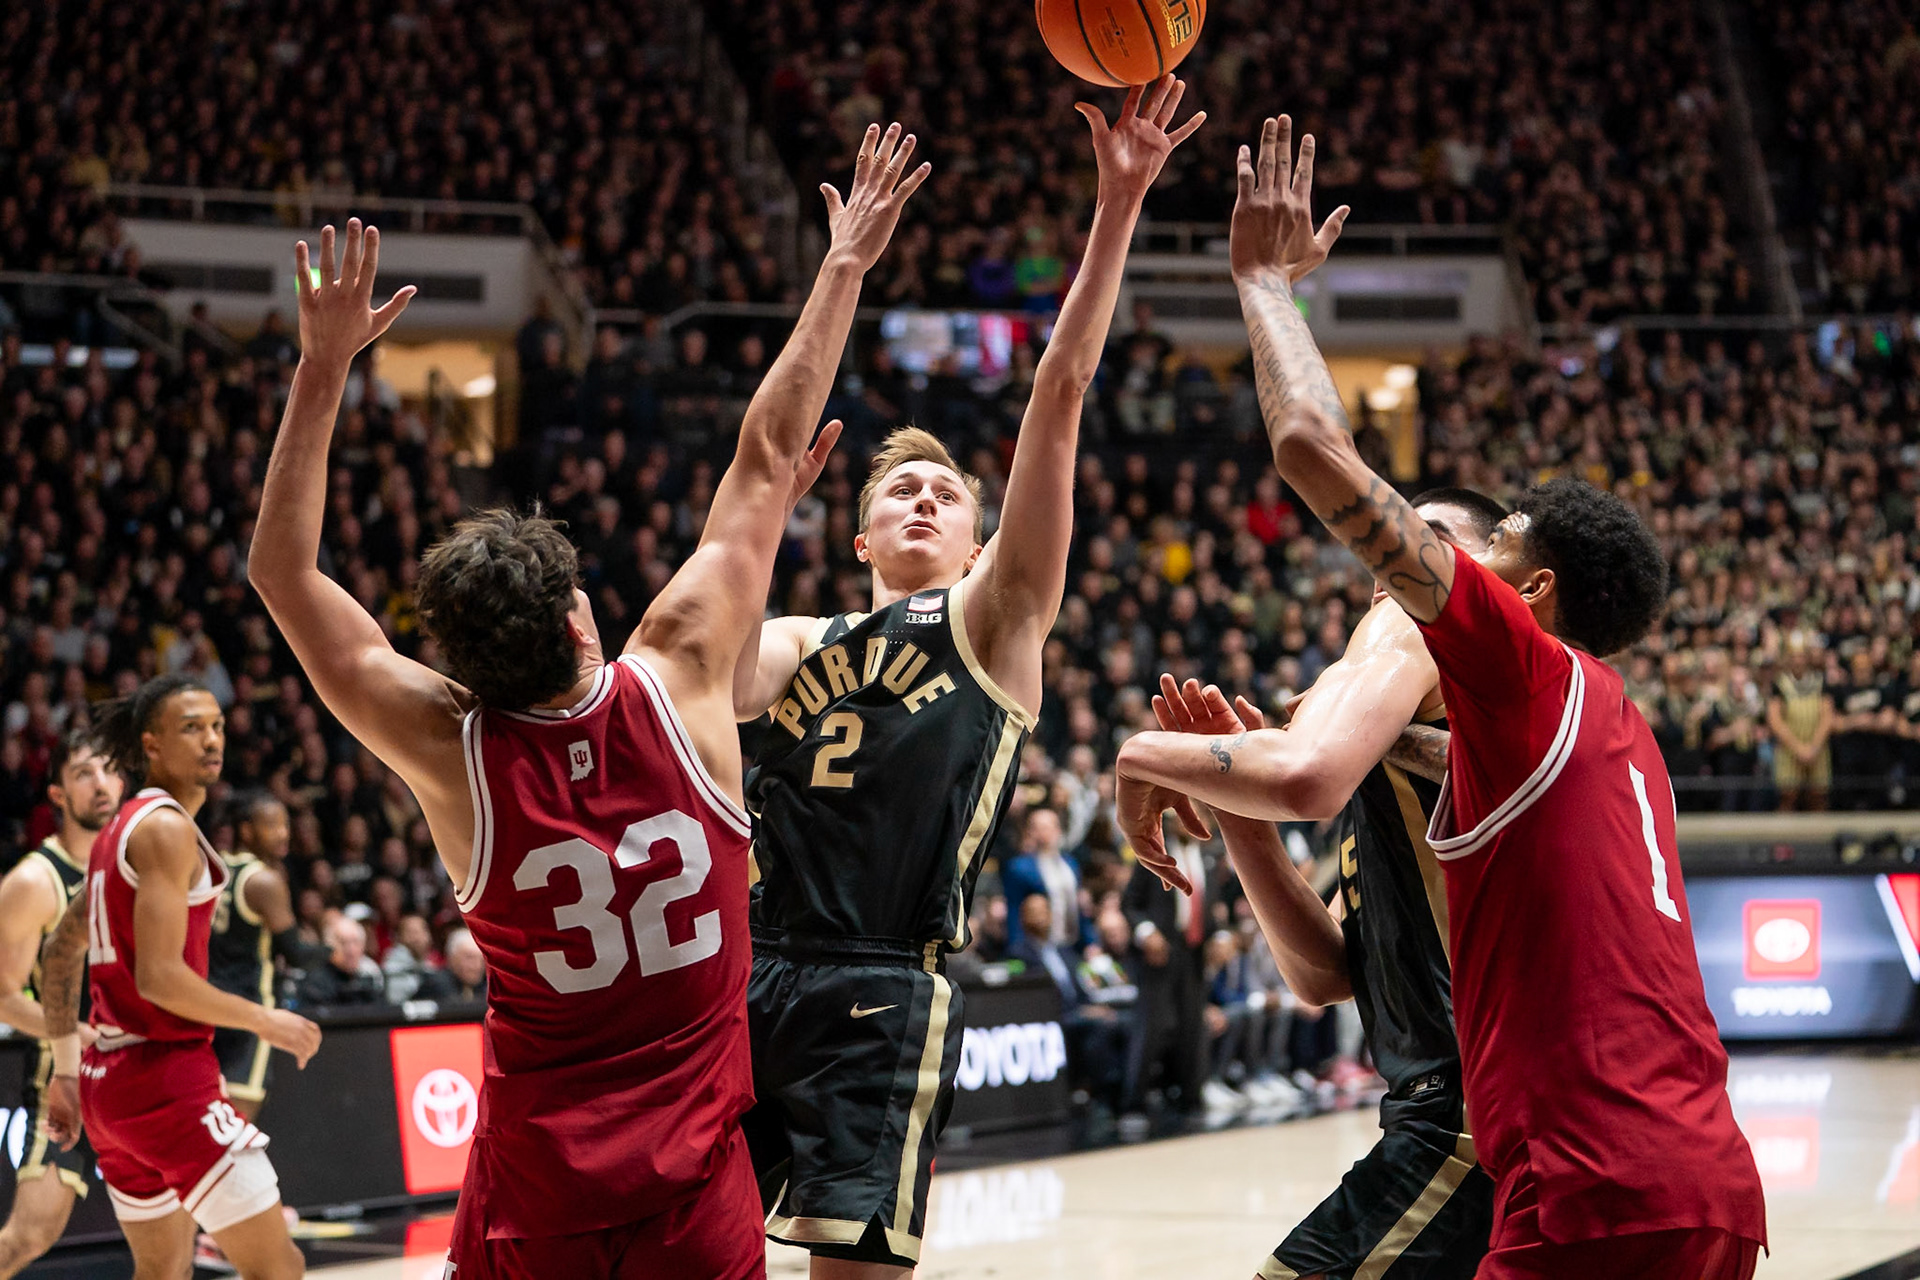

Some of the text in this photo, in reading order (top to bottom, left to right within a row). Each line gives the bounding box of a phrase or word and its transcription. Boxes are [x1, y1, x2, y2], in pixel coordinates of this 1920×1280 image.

[776, 636, 957, 740] PURDUE
[810, 711, 864, 788] 2
[1628, 760, 1682, 923] 1
[512, 808, 723, 995] 32
[1730, 986, 1833, 1017] TOYOTA
[954, 1020, 1067, 1092] OYOTA
